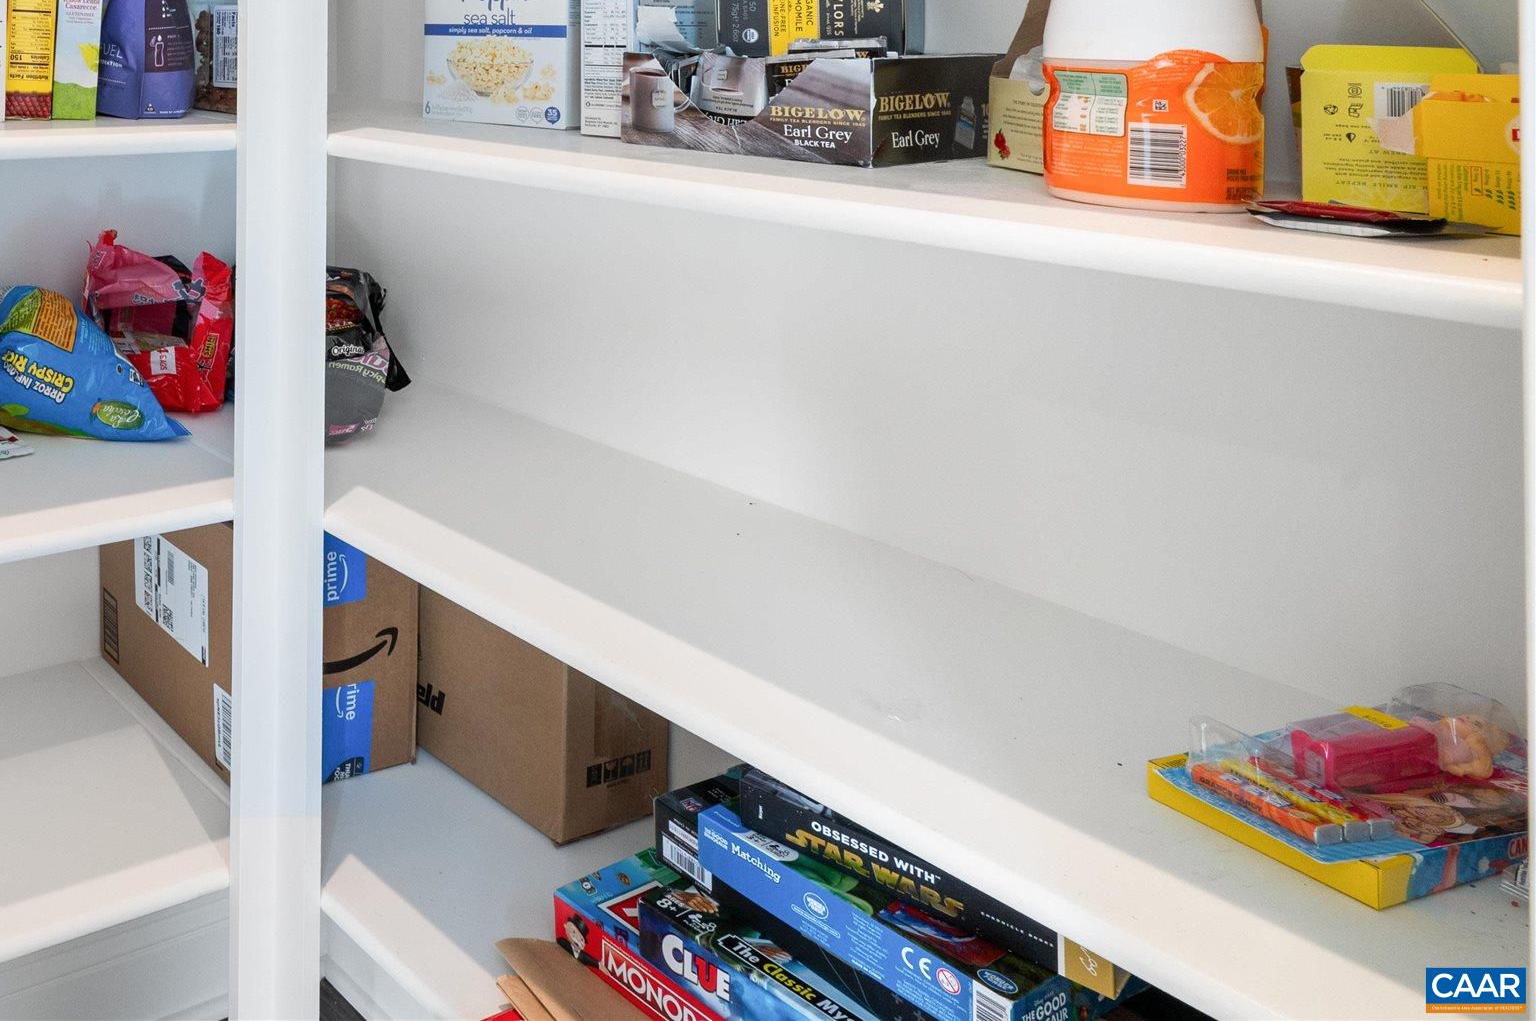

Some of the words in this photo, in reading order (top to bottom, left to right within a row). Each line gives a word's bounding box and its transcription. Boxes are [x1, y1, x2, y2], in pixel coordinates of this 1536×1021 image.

[464, 12, 487, 26] sea
[491, 9, 515, 26] salt
[772, 5, 780, 37] INFUSION
[101, 43, 124, 59] UEL
[425, 101, 431, 114] 6
[770, 105, 866, 121] BIGELOW
[879, 92, 950, 113] BIGELOW
[784, 124, 811, 138] Earl
[815, 126, 853, 143] Grey
[794, 139, 819, 147] BLACK
[820, 141, 836, 149] TEA
[891, 130, 913, 149] Earl
[915, 129, 940, 148] Grey
[204, 336, 218, 358] SHIN
[28, 361, 75, 394] CRISPY
[32, 380, 66, 404] ARROZ
[102, 404, 140, 423] Cosecha
[110, 414, 124, 428] La
[324, 551, 340, 602] prime
[811, 821, 889, 863] OBSESSED
[731, 842, 782, 883] Matching
[785, 828, 870, 878] STAR
[871, 860, 965, 918] WARS
[656, 897, 677, 915] 8+
[662, 933, 731, 1002] CLUE
[732, 942, 761, 964] The
[762, 961, 818, 1002] Classic
[1035, 992, 1067, 1020] GOOD
